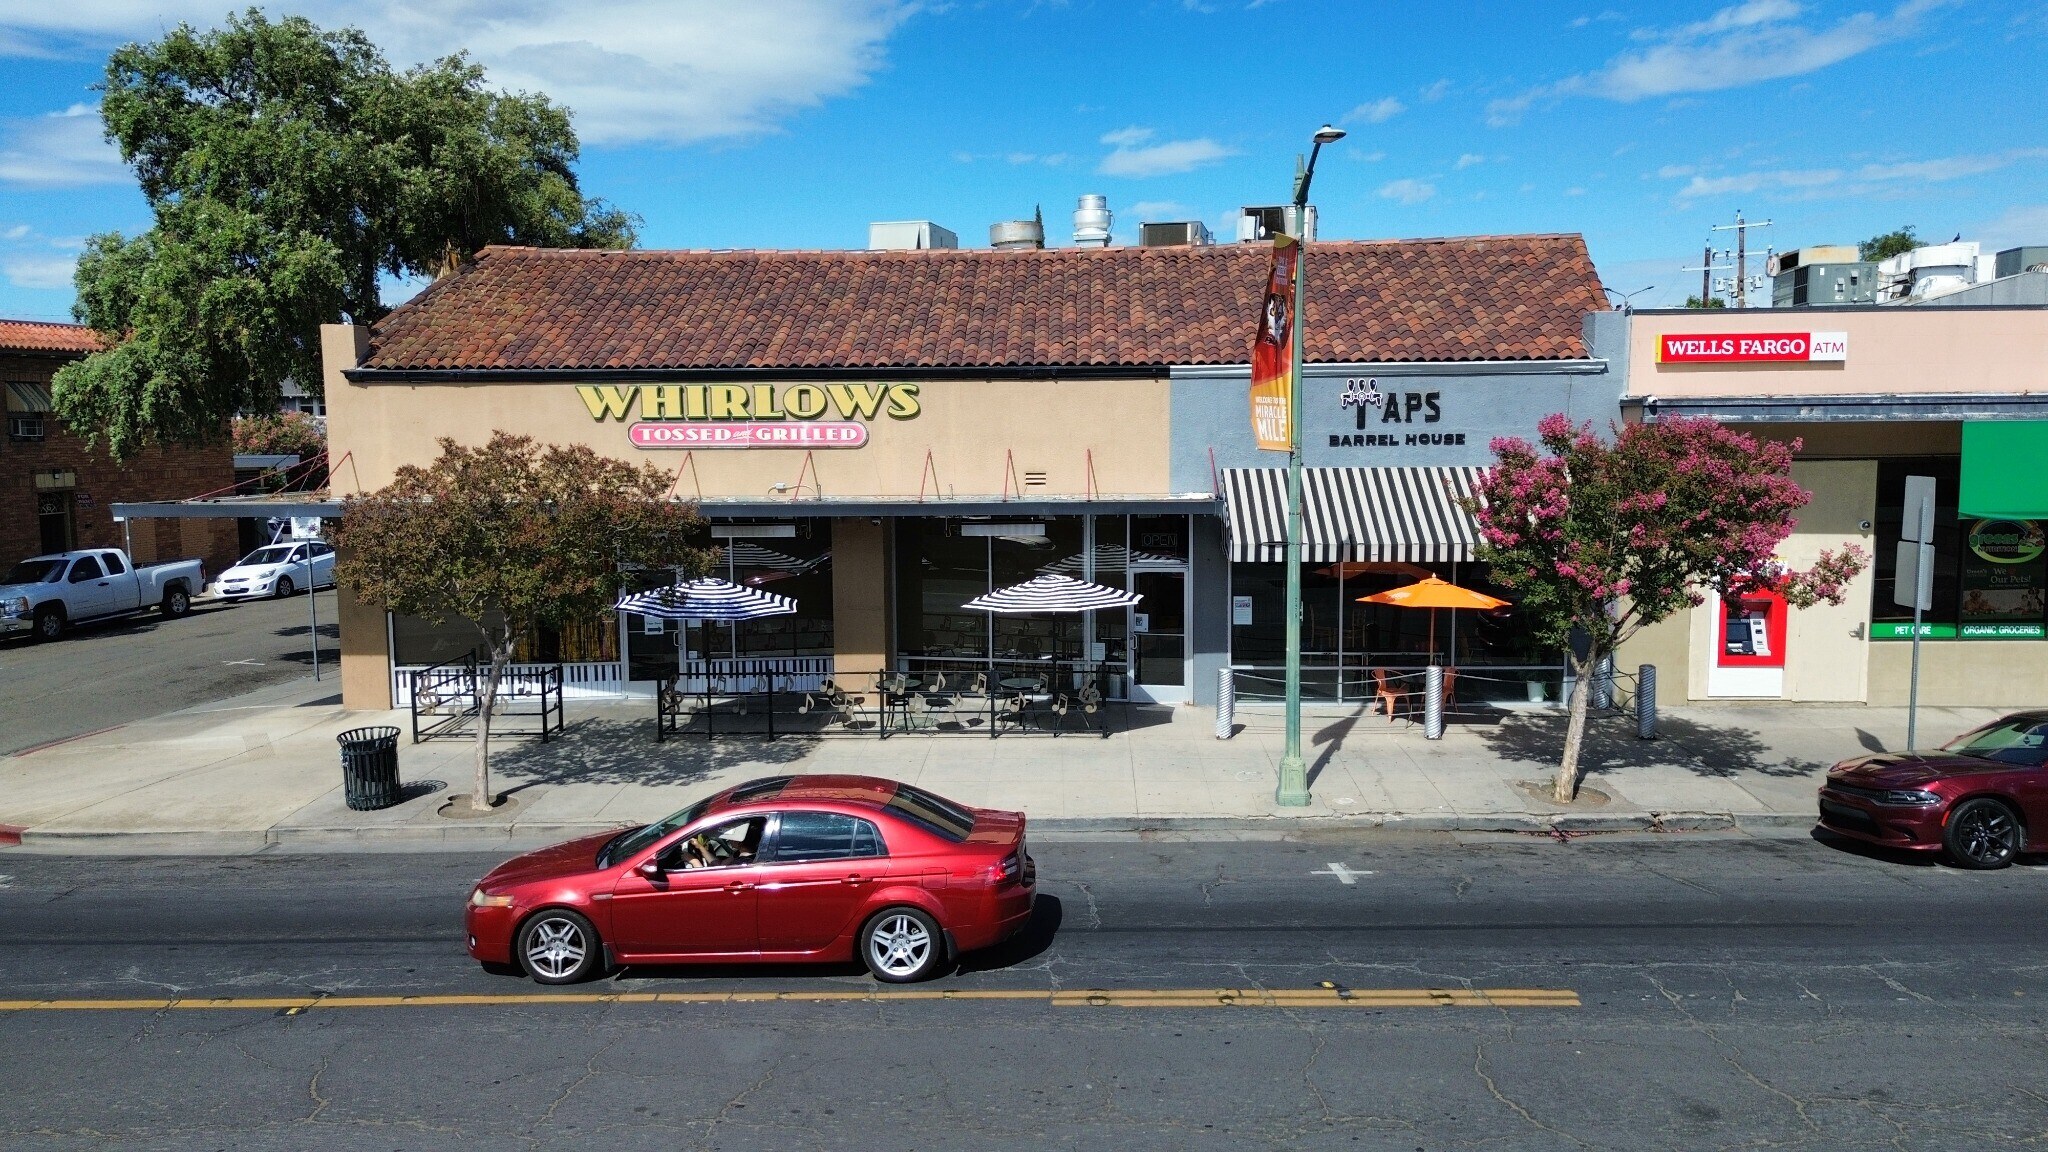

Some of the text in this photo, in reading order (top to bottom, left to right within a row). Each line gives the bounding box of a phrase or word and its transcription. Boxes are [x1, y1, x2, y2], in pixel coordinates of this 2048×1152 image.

[1667, 338, 1844, 355] WELLS FARGO ATM
[575, 383, 921, 422] WHIRLOWS
[1341, 378, 1441, 430] TAPS
[1255, 405, 1287, 418] MIRACLE
[638, 427, 733, 441] TOSSED
[756, 427, 858, 441] GRILLED
[1256, 418, 1286, 441] MILE
[1329, 433, 1465, 447] BARREL HOUSE
[1144, 534, 1176, 546] OPEN
[1994, 568, 2007, 576] We
[1990, 574, 2031, 584] Our Pets!
[1894, 626, 1909, 635] PET
[1964, 625, 2040, 635] ORGANIC GROCERIES
